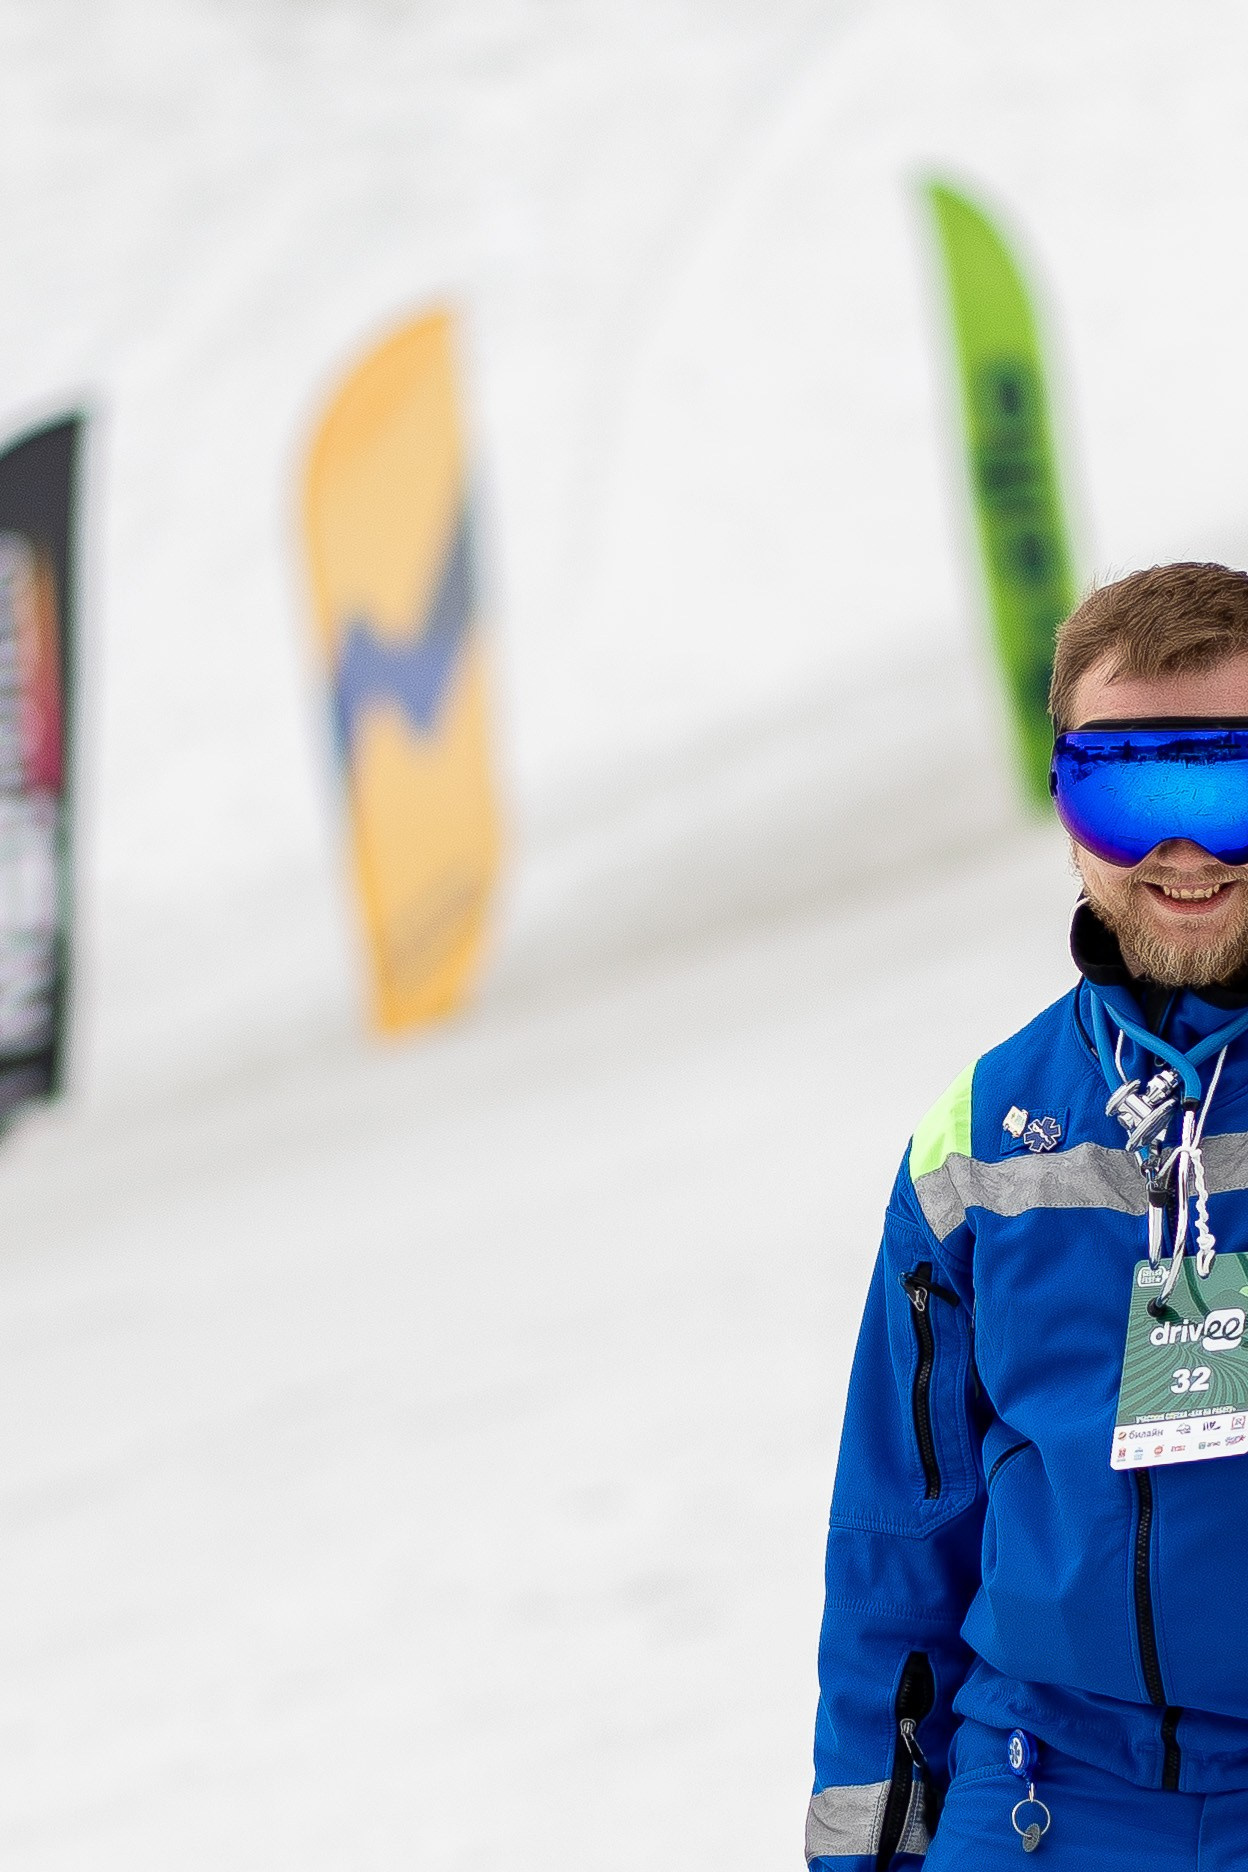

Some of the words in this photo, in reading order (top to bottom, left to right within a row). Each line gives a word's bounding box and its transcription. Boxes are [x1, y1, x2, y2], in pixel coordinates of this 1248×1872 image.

[1150, 1309, 1246, 1350] drivee
[1170, 1366, 1212, 1394] 32
[1128, 1428, 1164, 1440] билайн
